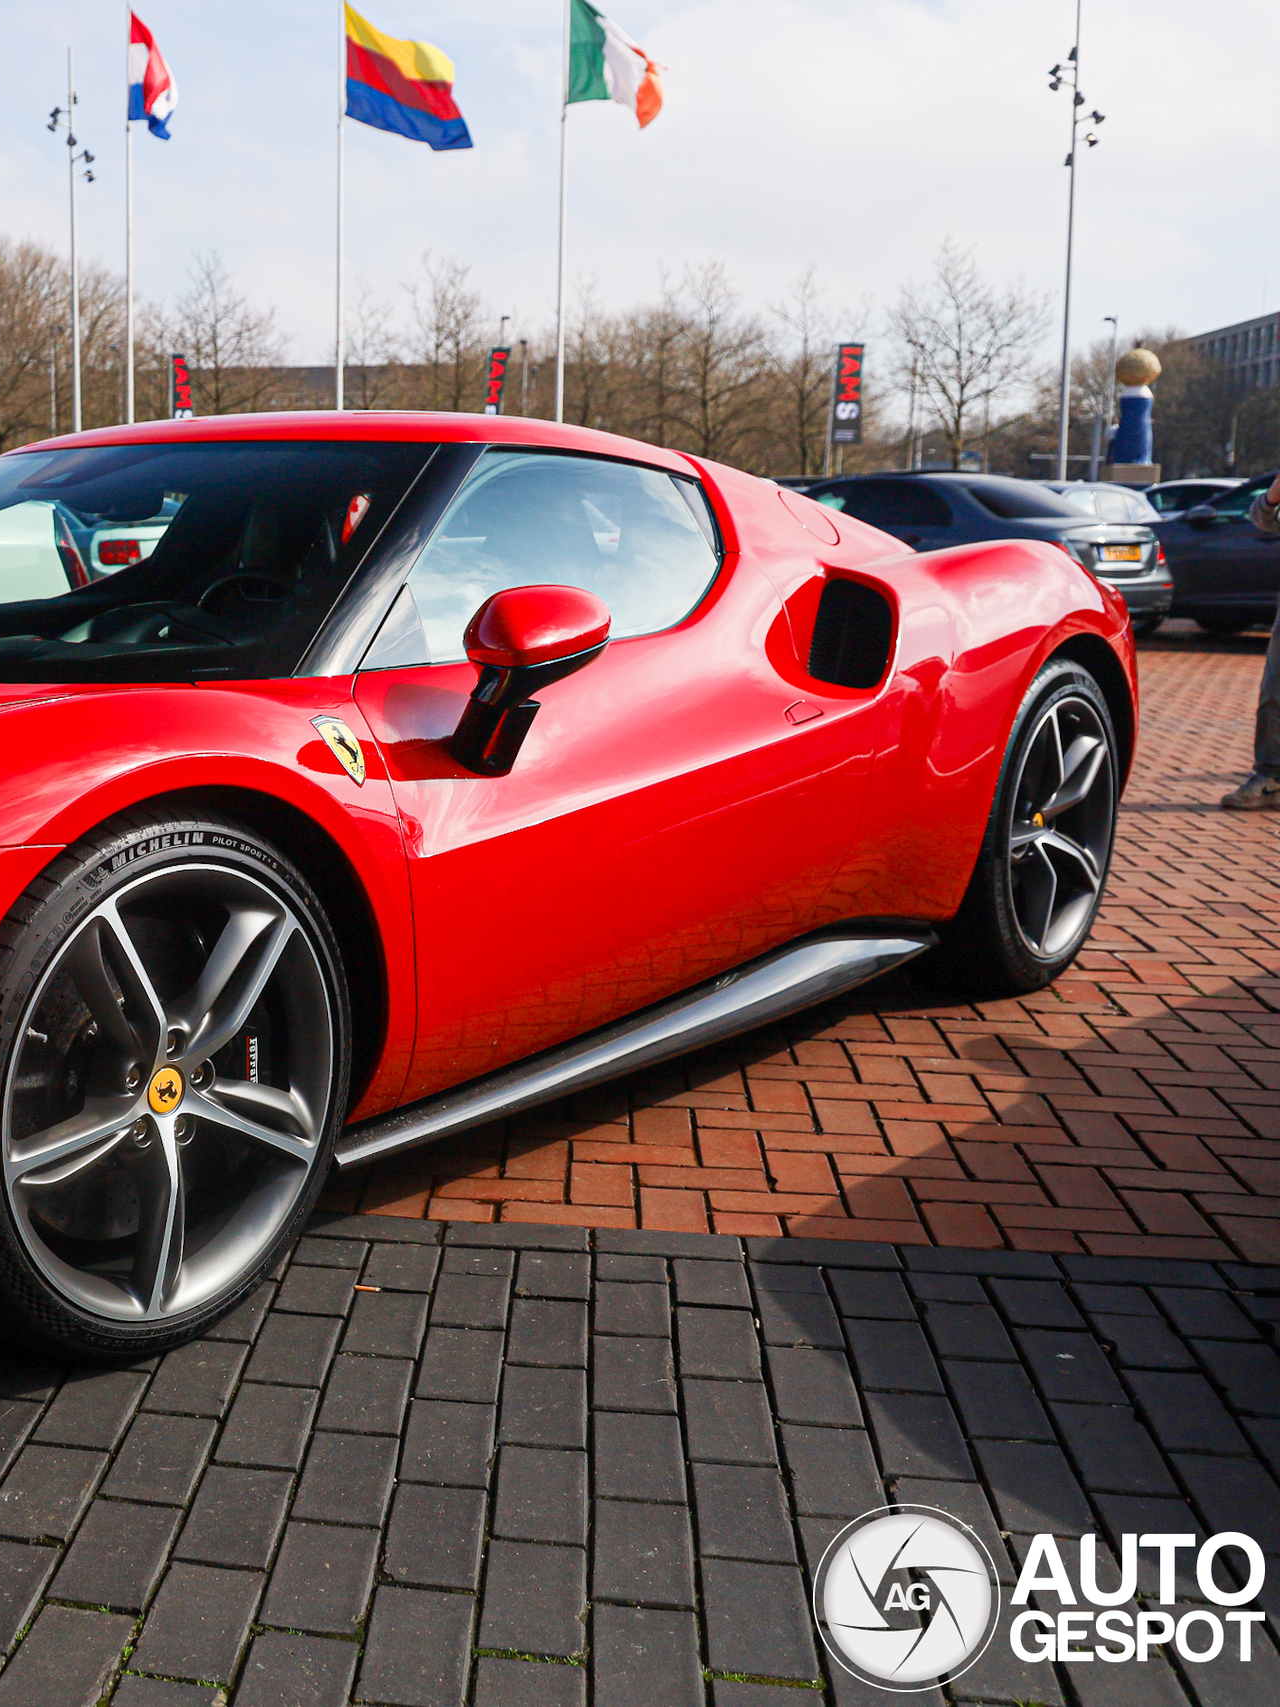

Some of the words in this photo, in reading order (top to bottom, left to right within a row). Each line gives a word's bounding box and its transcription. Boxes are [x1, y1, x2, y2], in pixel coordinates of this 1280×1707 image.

[111, 832, 204, 870] MICHELIN
[212, 836, 238, 848] PILOT
[249, 1037, 258, 1084] Ferrar
